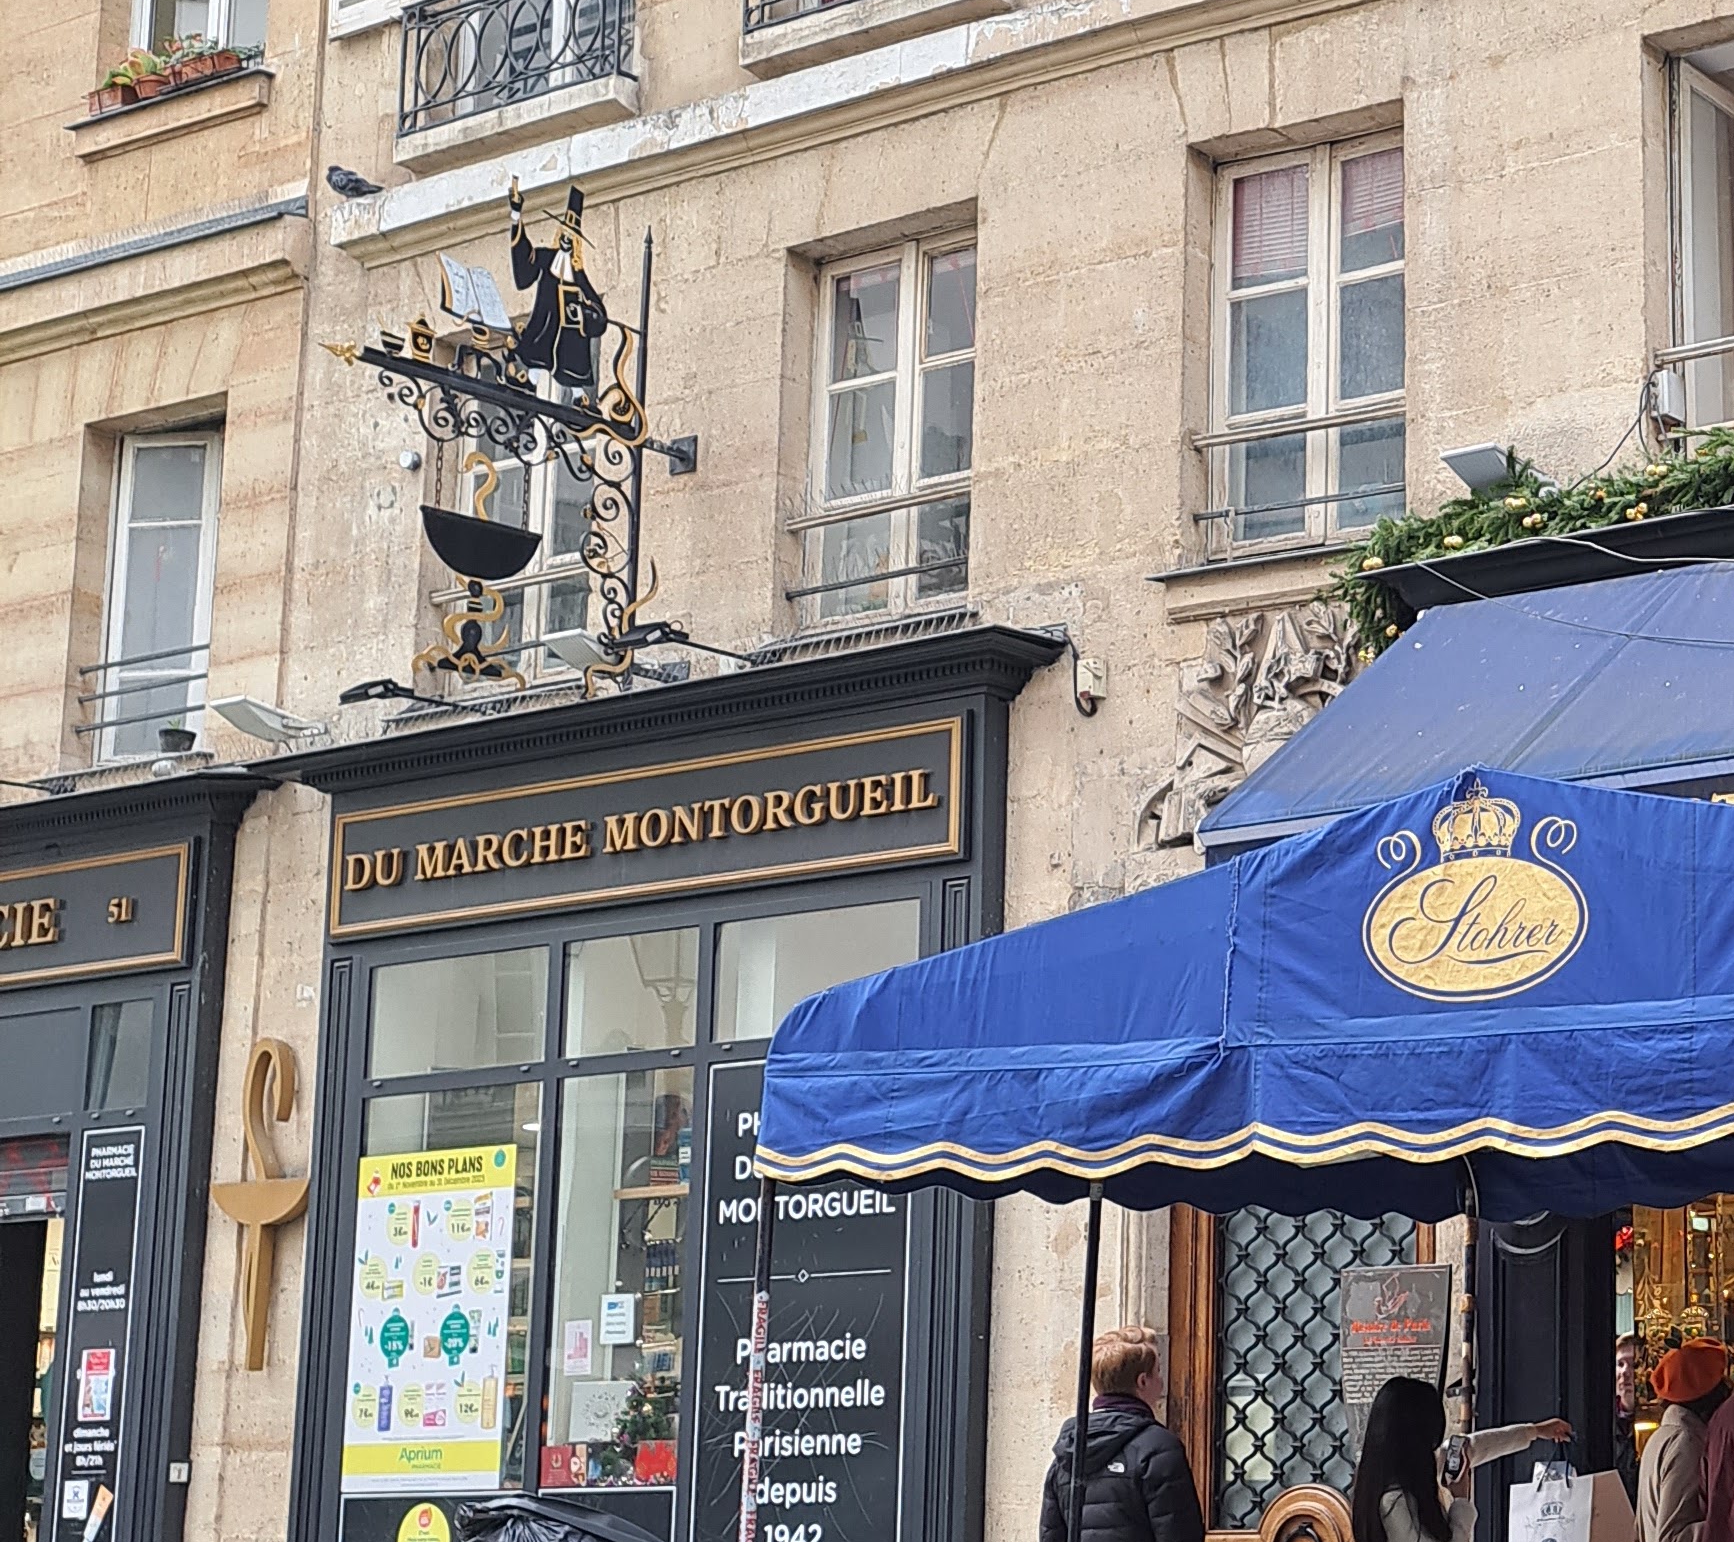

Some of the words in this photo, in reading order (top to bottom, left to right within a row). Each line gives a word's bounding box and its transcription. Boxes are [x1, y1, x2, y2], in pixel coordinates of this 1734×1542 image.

[344, 847, 402, 891] DU
[414, 820, 592, 881] MARCHE
[603, 768, 938, 855] MONTORGUEIL
[107, 897, 134, 924] 51
[1388, 873, 1564, 965] Stohrer
[391, 1161, 413, 1180] NOS
[416, 1158, 445, 1178] BONS
[448, 1155, 483, 1175] PLANS
[719, 1189, 896, 1225] MOTORGUEIL
[736, 1333, 867, 1364] Parmacie
[398, 1444, 443, 1463] Aprium
[733, 1429, 862, 1457] Prisienne
[756, 1476, 837, 1509] depuis
